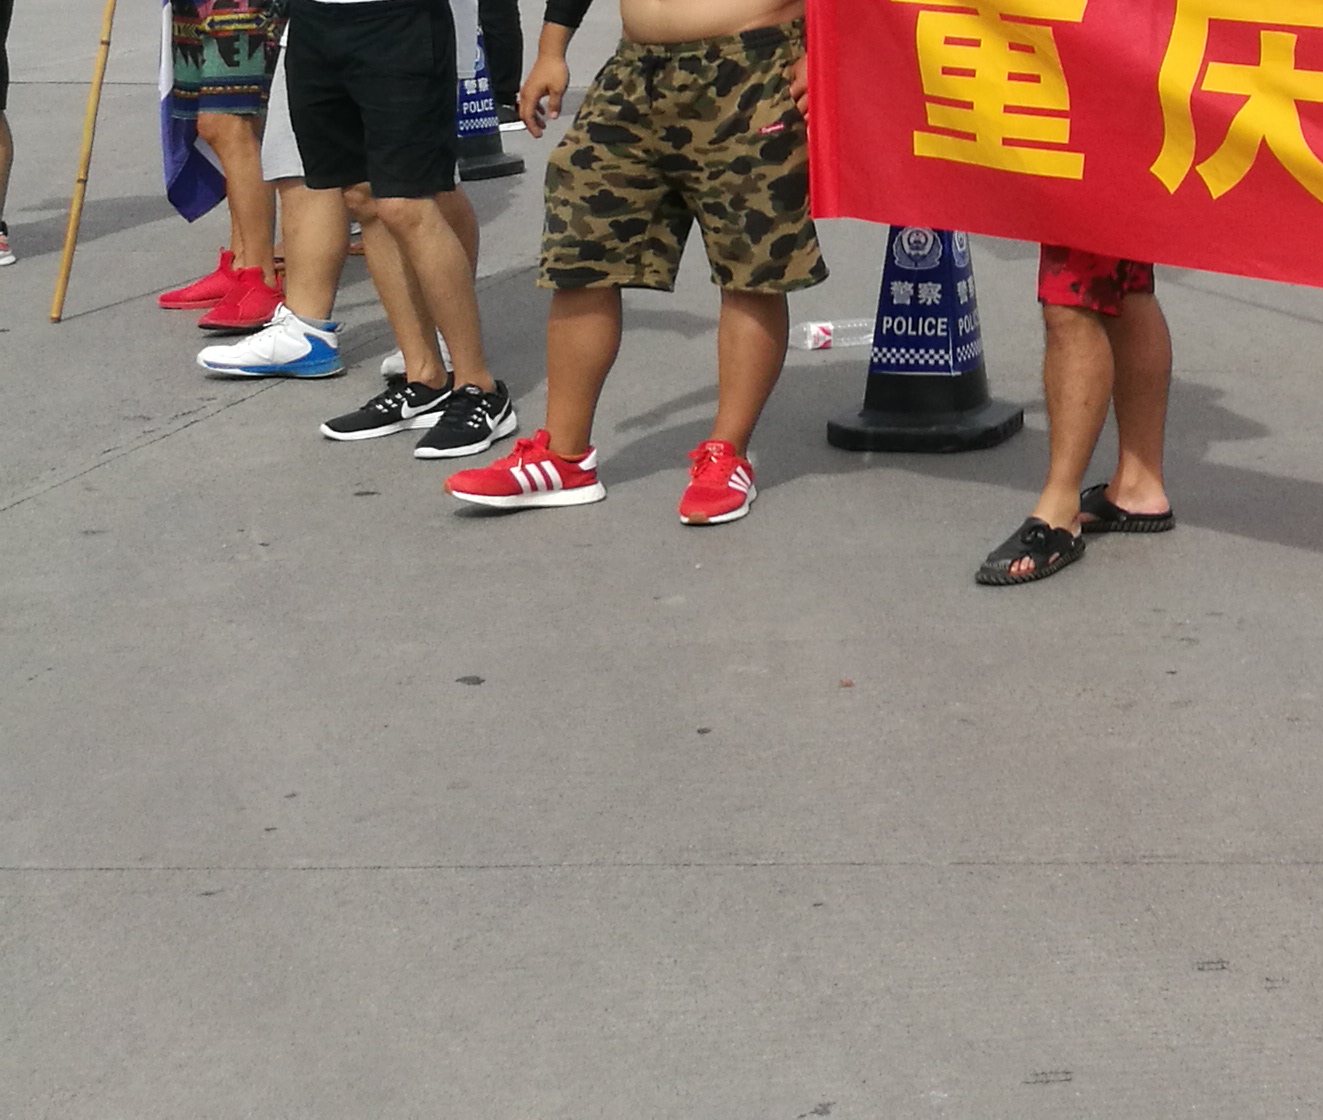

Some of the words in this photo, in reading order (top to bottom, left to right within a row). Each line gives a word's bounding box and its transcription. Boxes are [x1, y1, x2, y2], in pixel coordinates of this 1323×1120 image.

[463, 98, 495, 115] POLICE
[890, 281, 942, 305] 警察
[883, 316, 948, 336] POLICE
